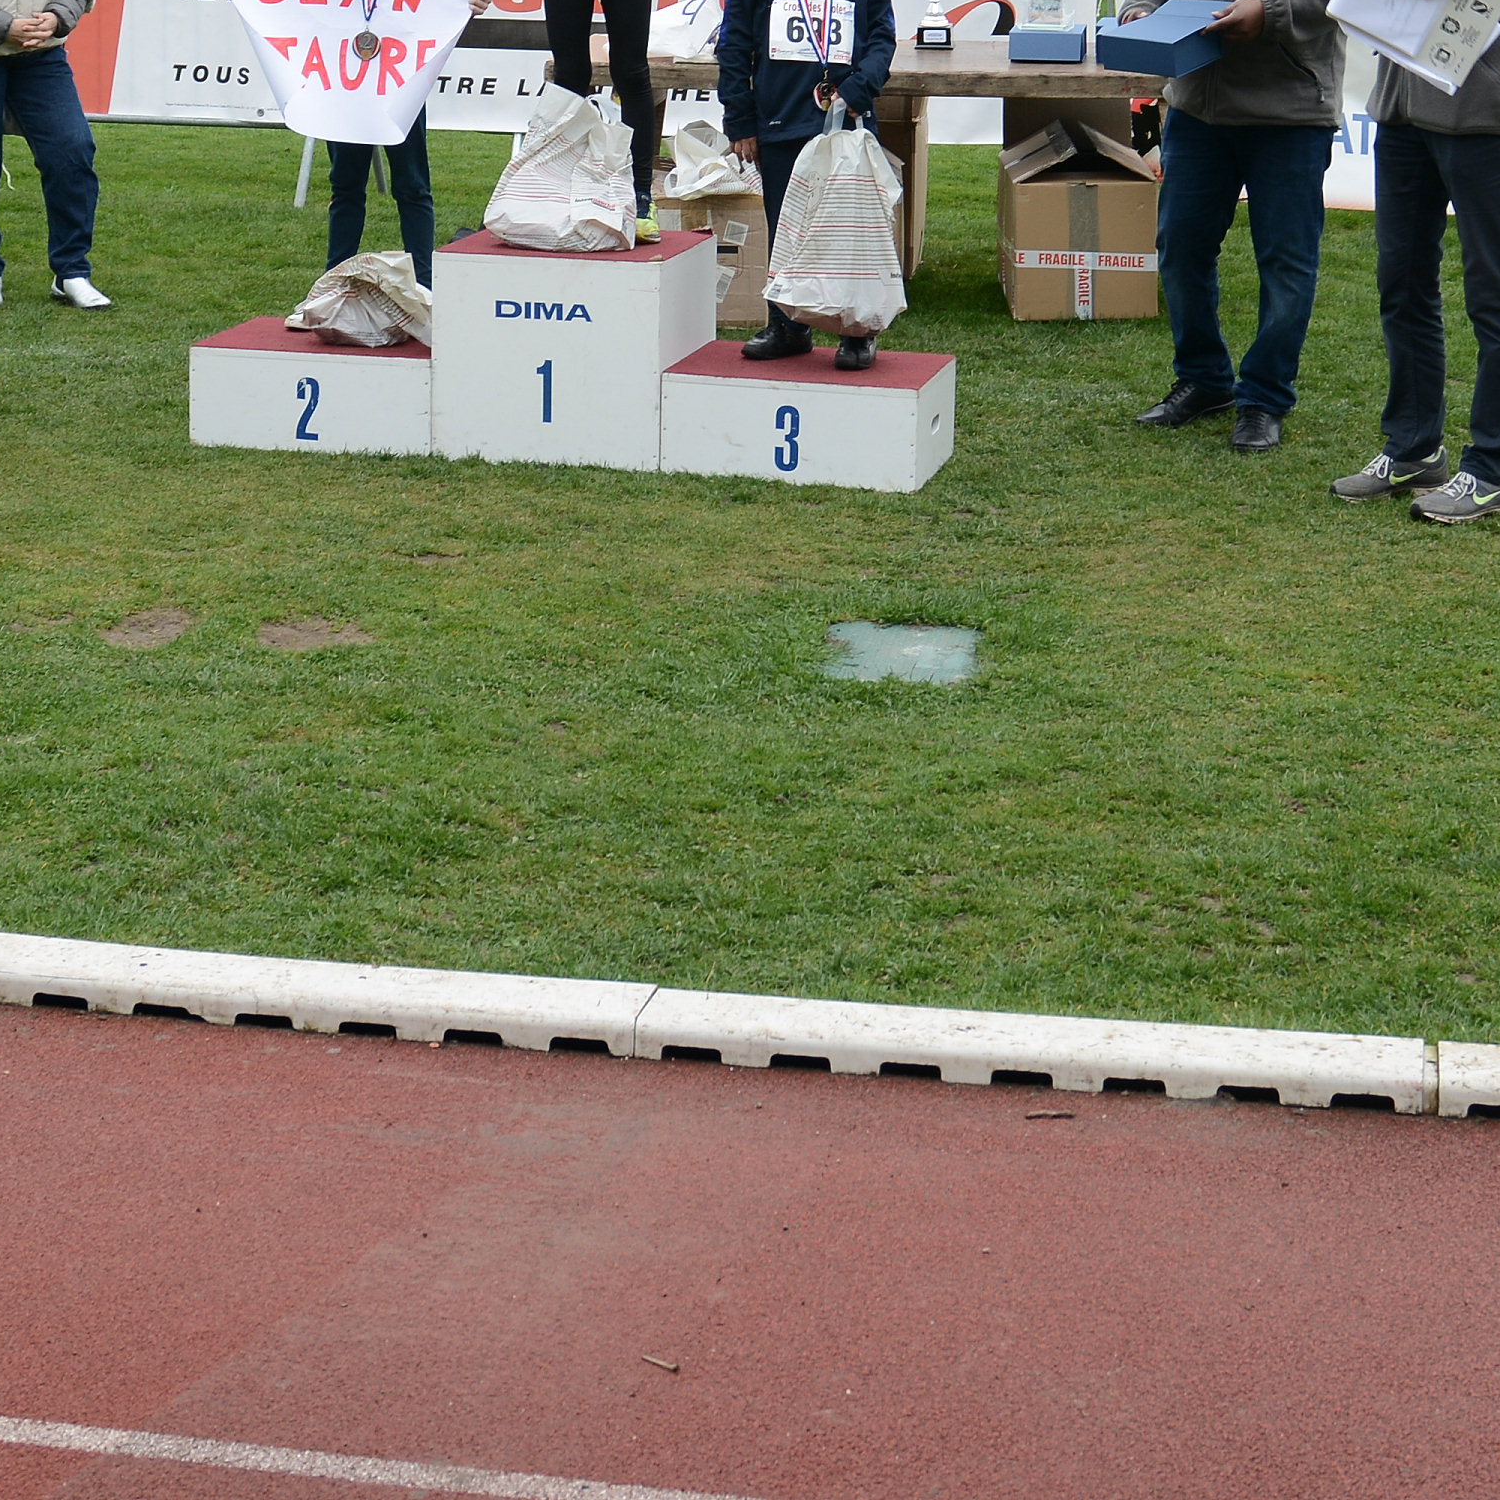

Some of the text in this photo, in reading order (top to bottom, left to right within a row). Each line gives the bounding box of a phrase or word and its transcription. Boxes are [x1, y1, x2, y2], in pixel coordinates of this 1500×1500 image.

[173, 64, 250, 85] TOUS
[437, 75, 497, 96] TRE
[1038, 253, 1085, 266] FRAGILE
[1098, 254, 1144, 268] FRAGILE
[1078, 268, 1090, 307] RAGILE
[494, 299, 591, 323] DIMA
[536, 359, 553, 423] 1
[295, 376, 319, 442] 2
[774, 404, 800, 472] 3
